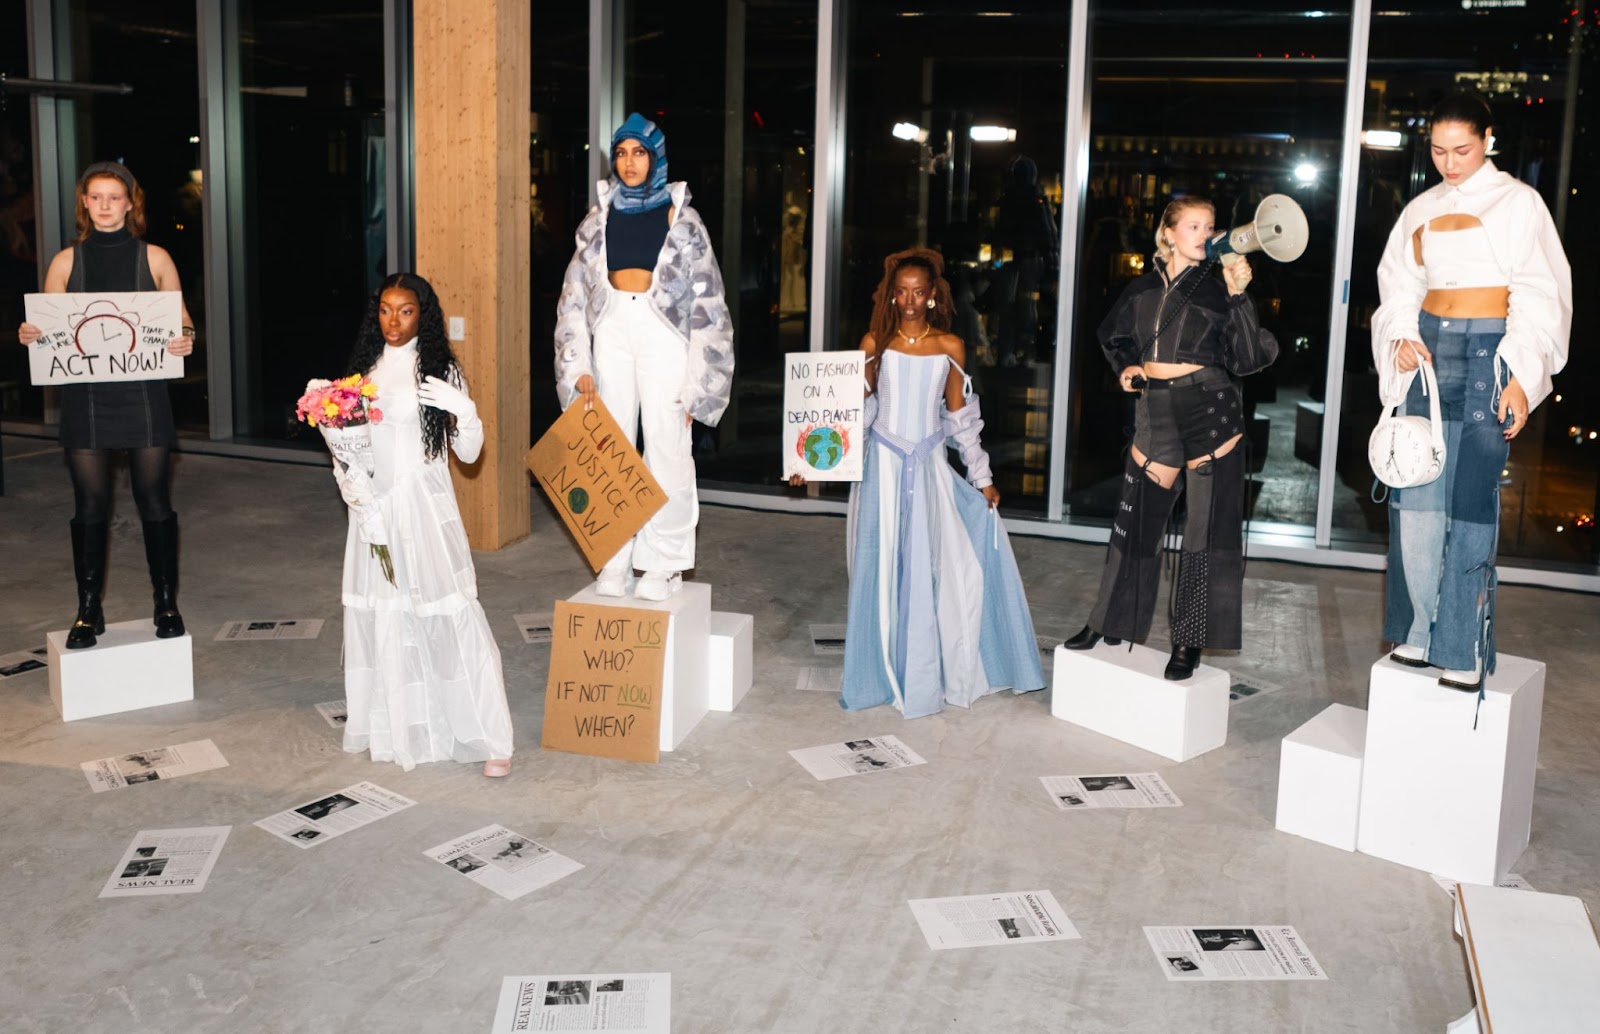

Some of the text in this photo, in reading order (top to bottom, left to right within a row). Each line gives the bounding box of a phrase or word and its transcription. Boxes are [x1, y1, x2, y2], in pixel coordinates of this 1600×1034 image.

[36, 335, 51, 345] NOT
[141, 326, 164, 335] TIME
[50, 348, 165, 378] ACT NOW!
[791, 362, 859, 380] NO FASHION
[803, 385, 835, 399] ON A
[788, 408, 860, 424] DEAD PLANET
[582, 409, 654, 508] CLIMATE
[567, 437, 630, 519] JUSTICE
[568, 613, 662, 645] IF NOT US
[583, 648, 635, 673] WHO?
[557, 681, 652, 705] IF NOT NOW
[574, 714, 636, 738] WHEN?
[437, 844, 471, 860] CLIMATE
[118, 880, 157, 888] NEWS
[516, 982, 536, 1030] REAL NEWS
